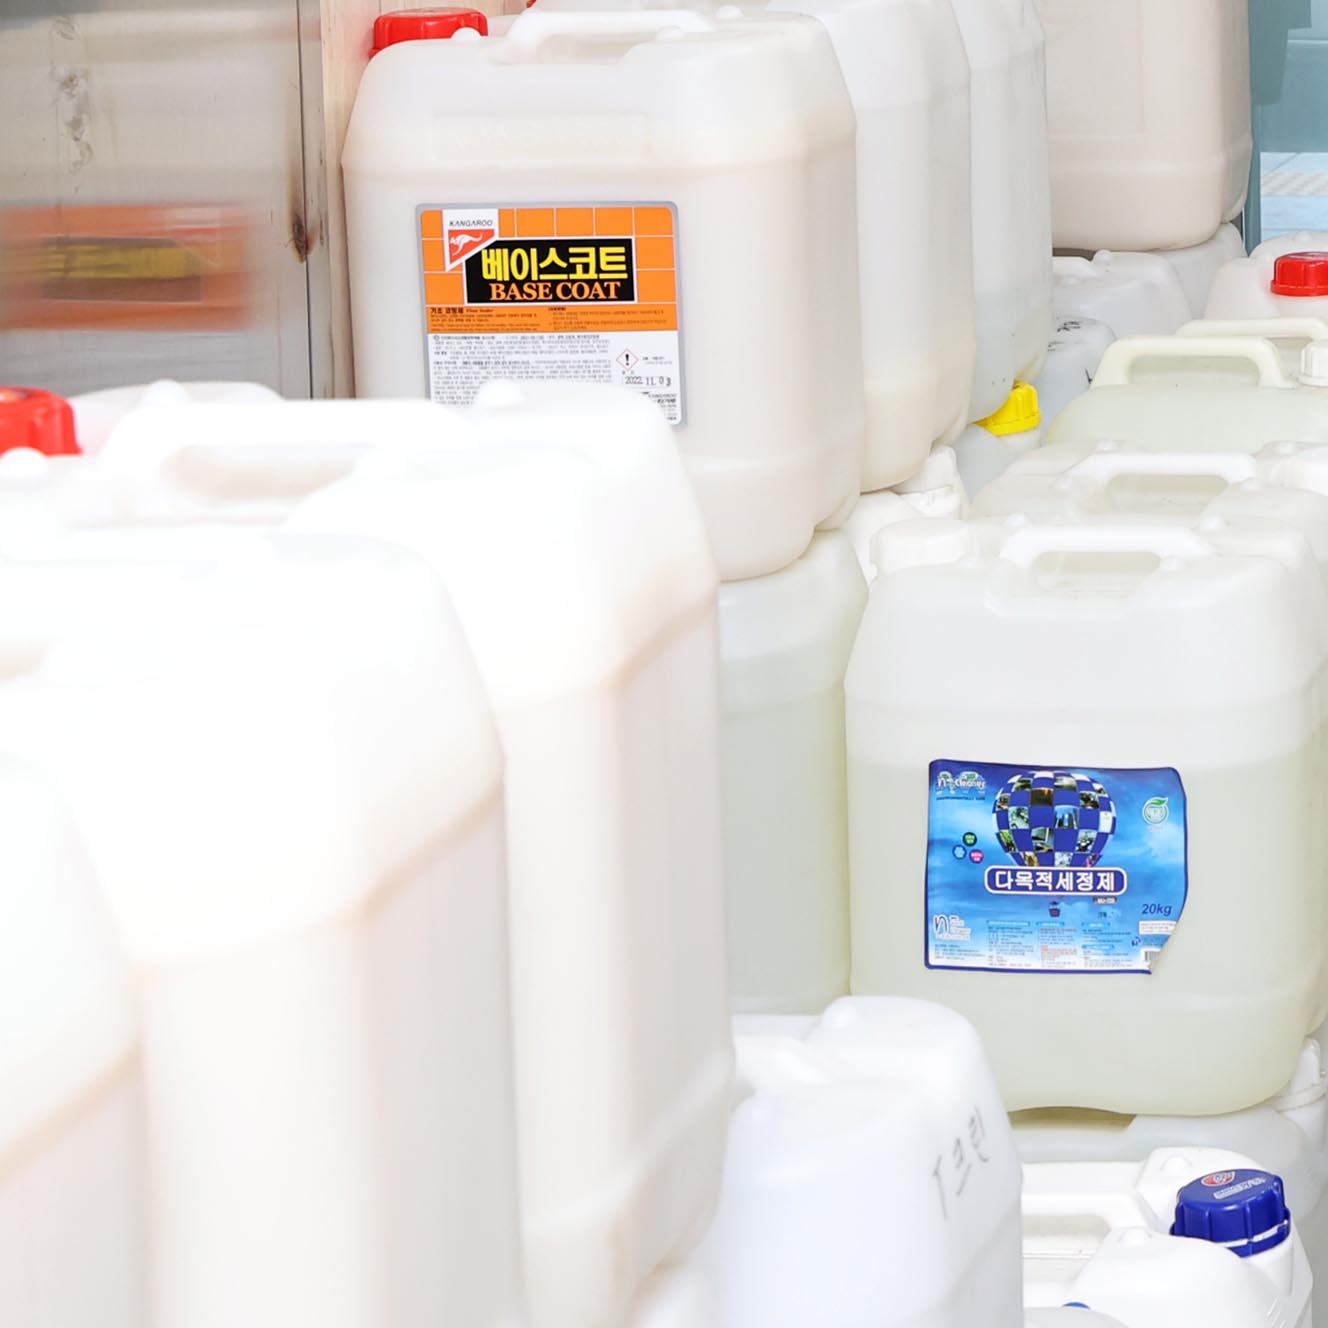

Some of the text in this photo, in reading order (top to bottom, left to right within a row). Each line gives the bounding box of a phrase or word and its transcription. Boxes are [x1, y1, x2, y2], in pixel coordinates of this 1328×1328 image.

[449, 219, 493, 228] KANGAROO
[481, 246, 628, 282] 베이스코트
[490, 281, 621, 301] BASE COAT
[994, 870, 1115, 892] 다목적세정제
[1142, 903, 1172, 917] 20kg
